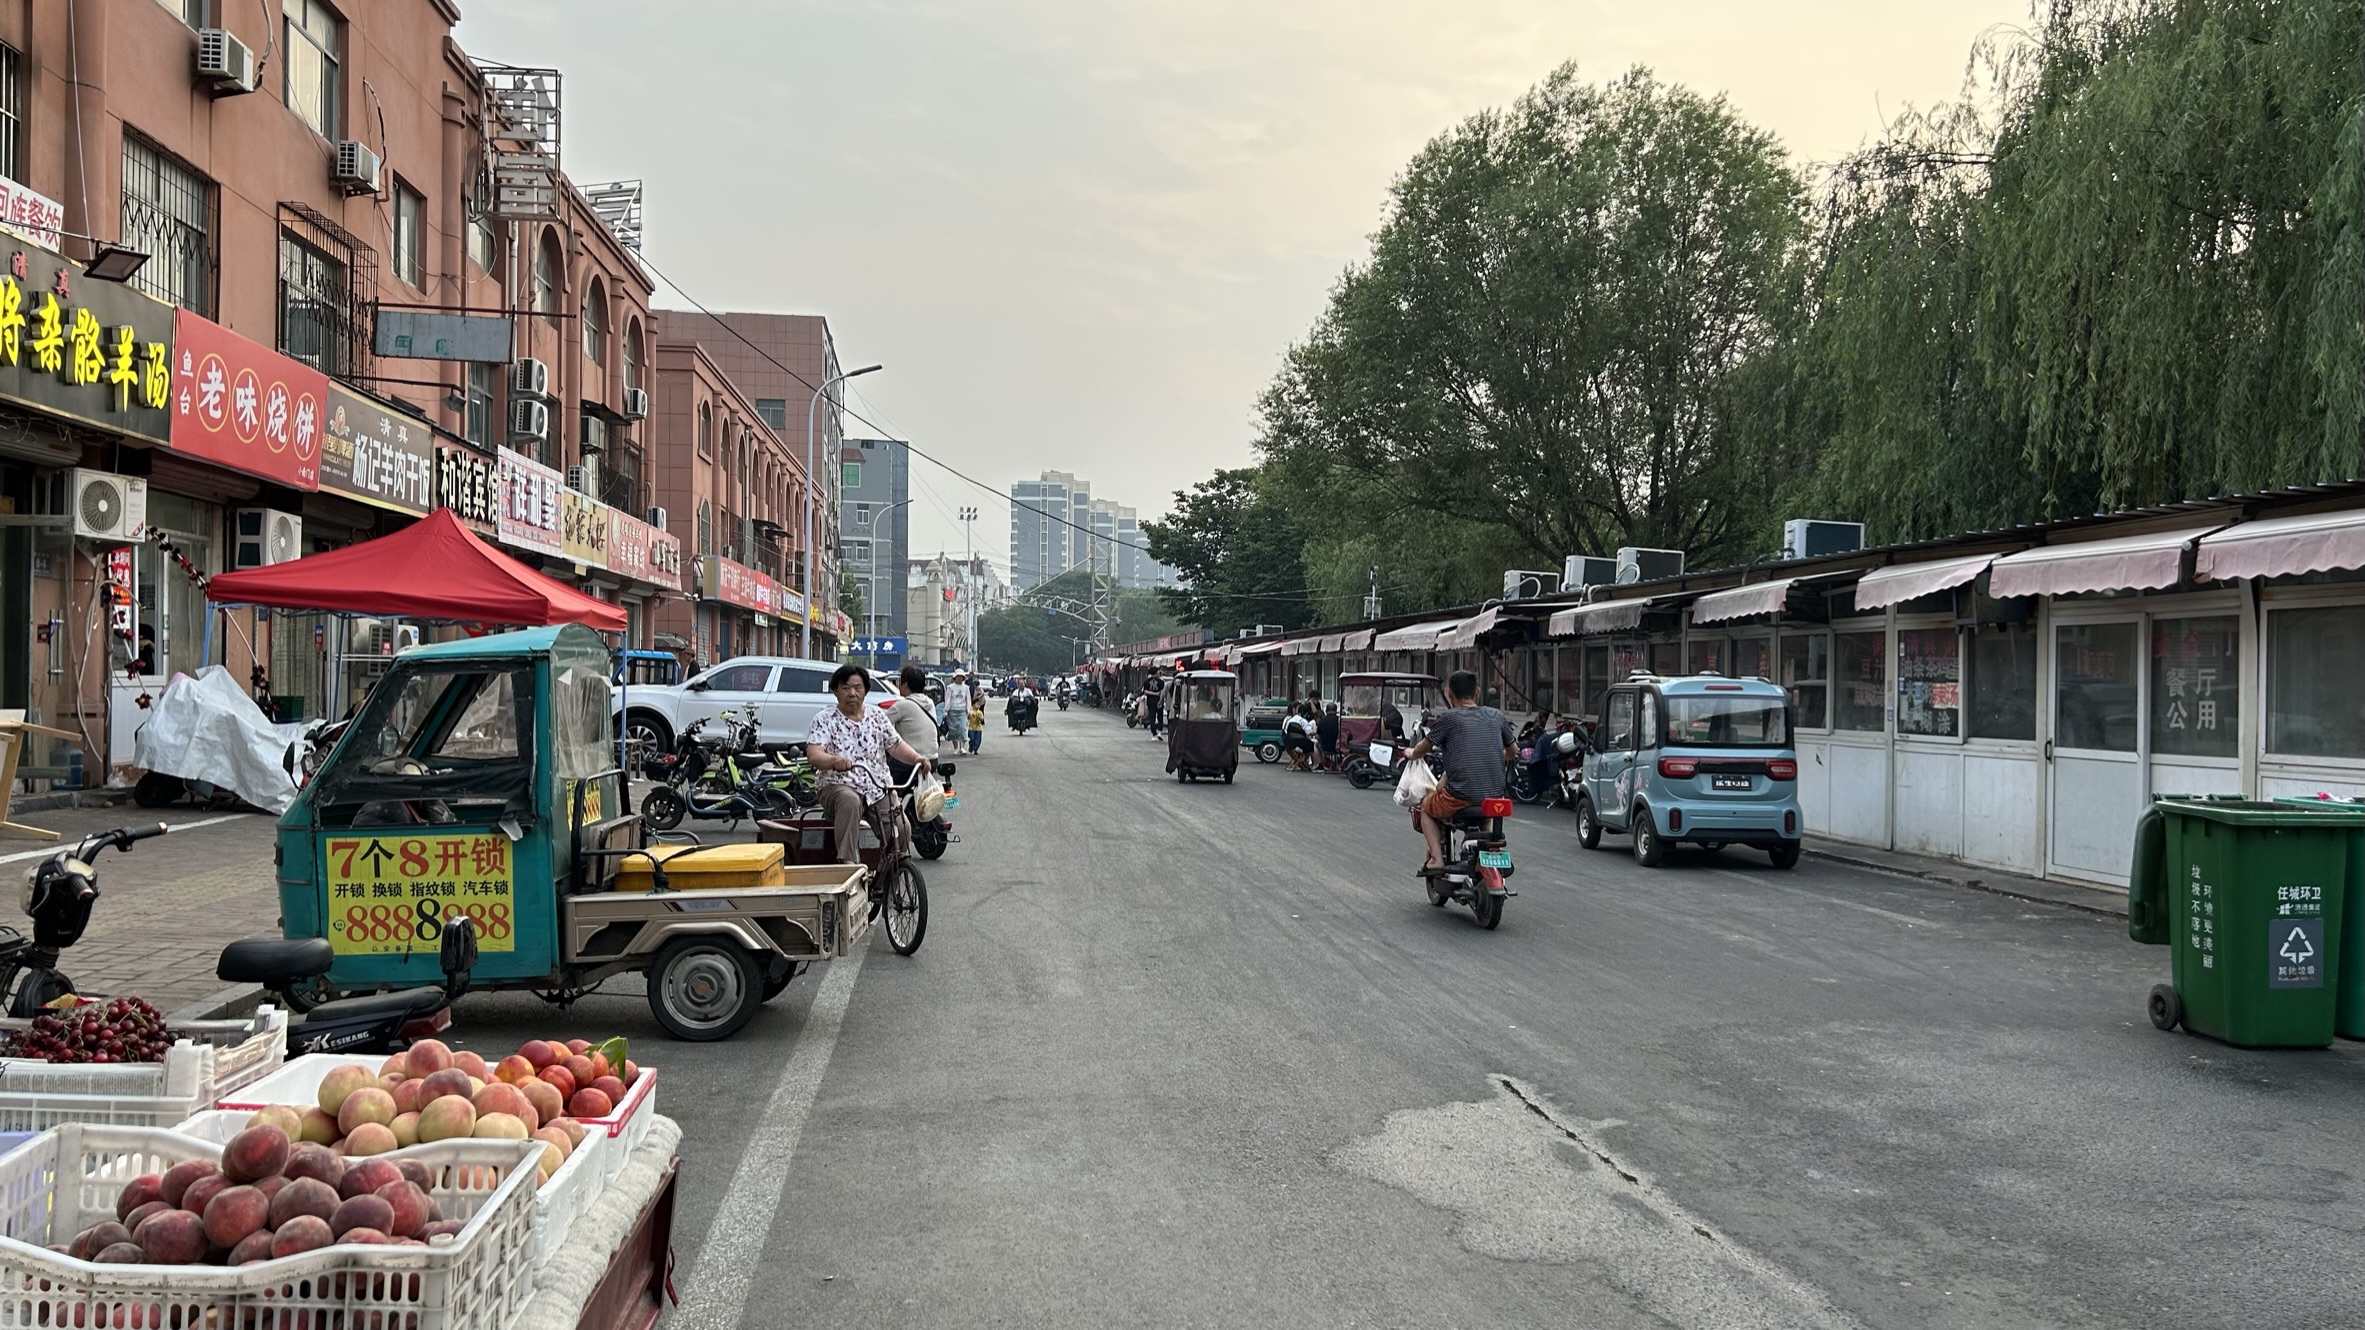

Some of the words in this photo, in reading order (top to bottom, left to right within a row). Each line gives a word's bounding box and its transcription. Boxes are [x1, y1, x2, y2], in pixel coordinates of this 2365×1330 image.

[179, 348, 193, 416] 鱼台
[199, 359, 315, 454] 老味烧饼
[380, 417, 408, 444] 清真
[352, 432, 430, 507] 杨记羊肉干饭
[441, 447, 498, 525] 和谐宾馆
[2166, 667, 2216, 698] 餐厅
[2166, 701, 2216, 731] 公用
[331, 837, 506, 879] 7个8开锁
[335, 883, 365, 899] 开锁
[372, 882, 403, 898] 换锁
[410, 881, 455, 898] 指纹锁
[463, 880, 509, 896] 汽车锁
[2277, 886, 2321, 900] 任城环卫
